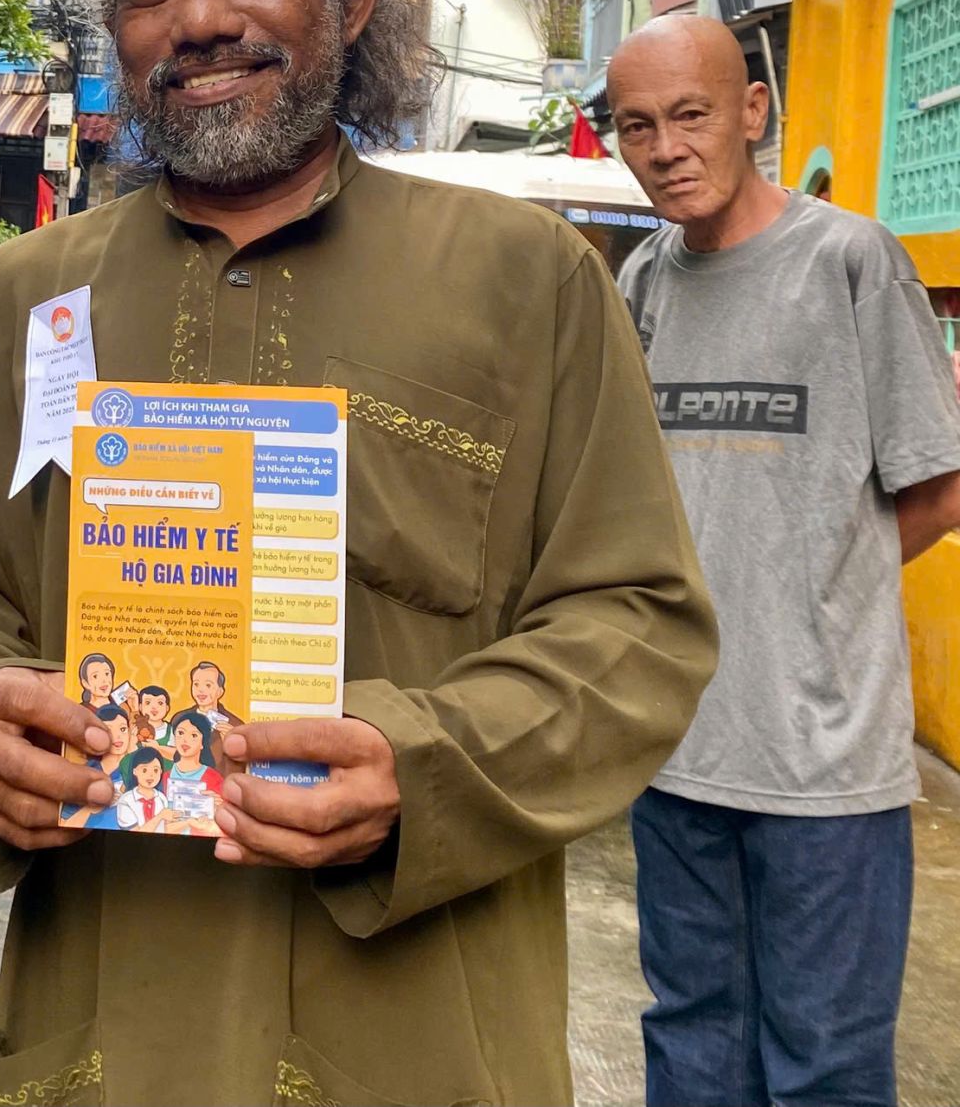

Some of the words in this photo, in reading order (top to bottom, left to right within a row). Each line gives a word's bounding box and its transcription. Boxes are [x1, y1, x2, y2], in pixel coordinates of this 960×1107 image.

[144, 401, 160, 412] LỢI
[162, 400, 179, 411] ÍCH
[181, 402, 198, 412] KHI
[201, 403, 230, 412] THAM
[232, 404, 249, 413] GIA
[144, 410, 165, 424] BẢO
[167, 412, 192, 424] HIỂM
[194, 414, 207, 425] XÃ
[210, 414, 228, 428] HỘI
[231, 416, 245, 428] TỰ
[247, 417, 290, 430] NGUYỆN
[257, 452, 278, 462] hiểm
[280, 454, 295, 462] của
[297, 455, 319, 465] Đảng
[267, 465, 290, 473] Nhân
[292, 466, 310, 474] dân,
[312, 467, 333, 476] được
[268, 476, 281, 485] hội
[283, 476, 300, 486] thực
[302, 477, 319, 487] hiện
[89, 486, 127, 496] NHỮNG
[129, 486, 153, 497] ĐIỀU
[178, 488, 199, 499] BIẾT
[83, 516, 125, 546] BẢO
[133, 517, 187, 549] HIỂM
[195, 528, 208, 550] Y
[215, 522, 241, 552] TẾ
[122, 558, 147, 587] HỘ
[154, 563, 185, 584] GIA
[191, 561, 237, 587] ĐÌNH
[273, 610, 285, 618] gia
[290, 638, 307, 646] theo
[290, 774, 311, 783] hôm
